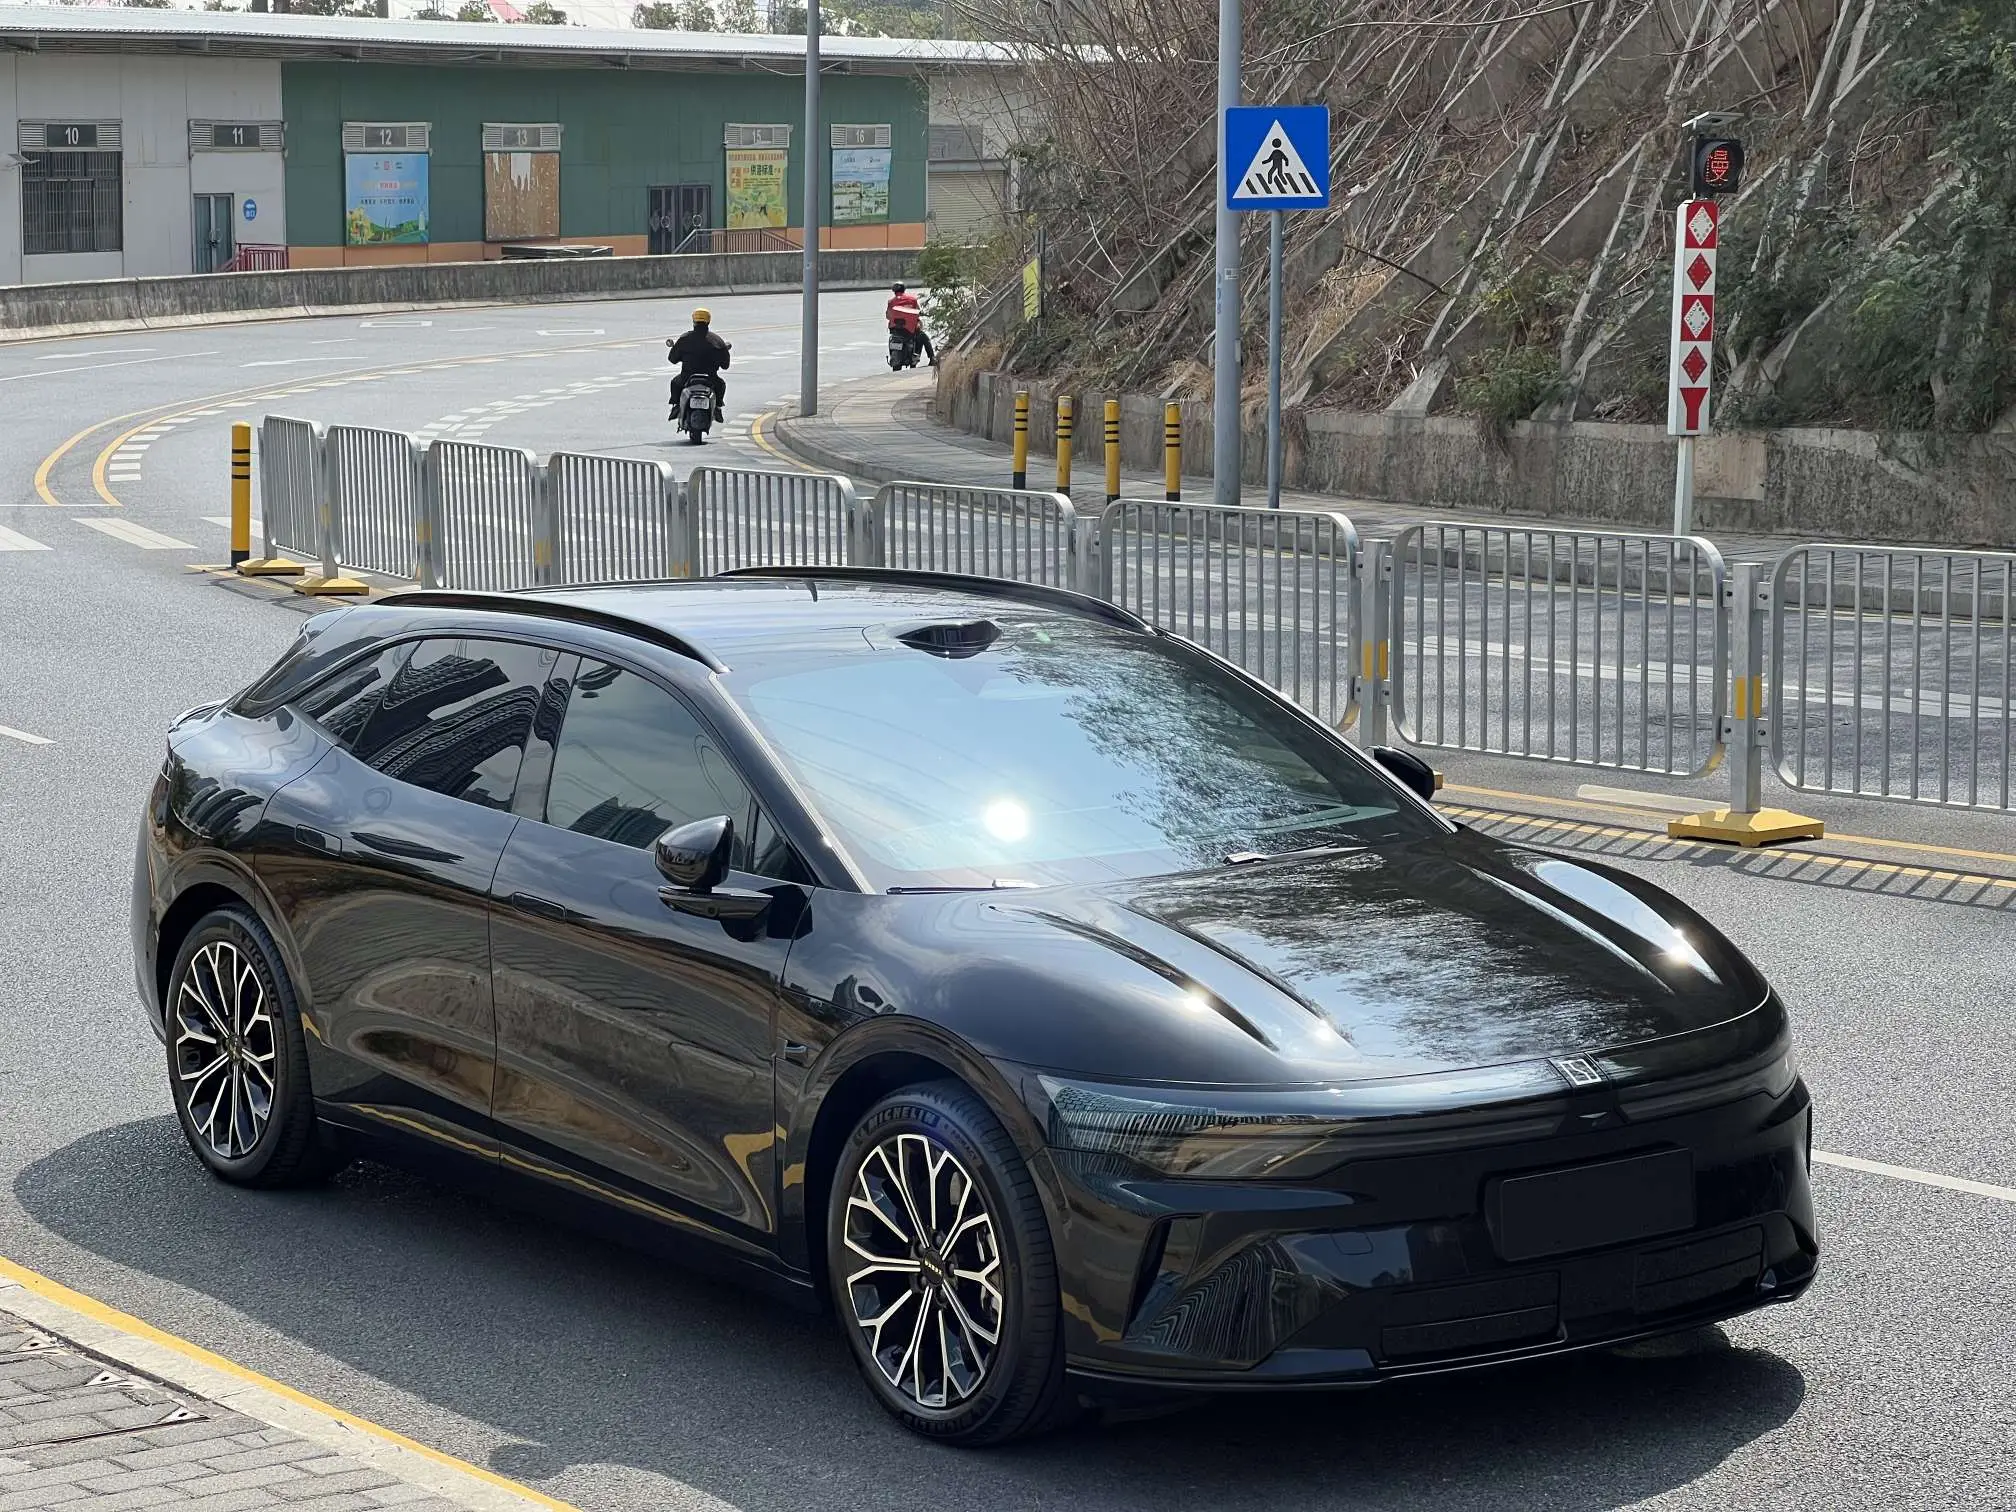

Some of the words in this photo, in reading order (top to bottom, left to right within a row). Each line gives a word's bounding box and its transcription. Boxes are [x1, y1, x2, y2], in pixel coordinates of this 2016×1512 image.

[65, 127, 79, 145] 10
[232, 127, 244, 145] 11
[379, 128, 393, 145] 12
[517, 128, 528, 145] 13
[752, 129, 762, 145] 15
[856, 128, 865, 144] 16
[1705, 150, 1729, 183] 慢
[868, 1106, 938, 1134] MICHELIN
